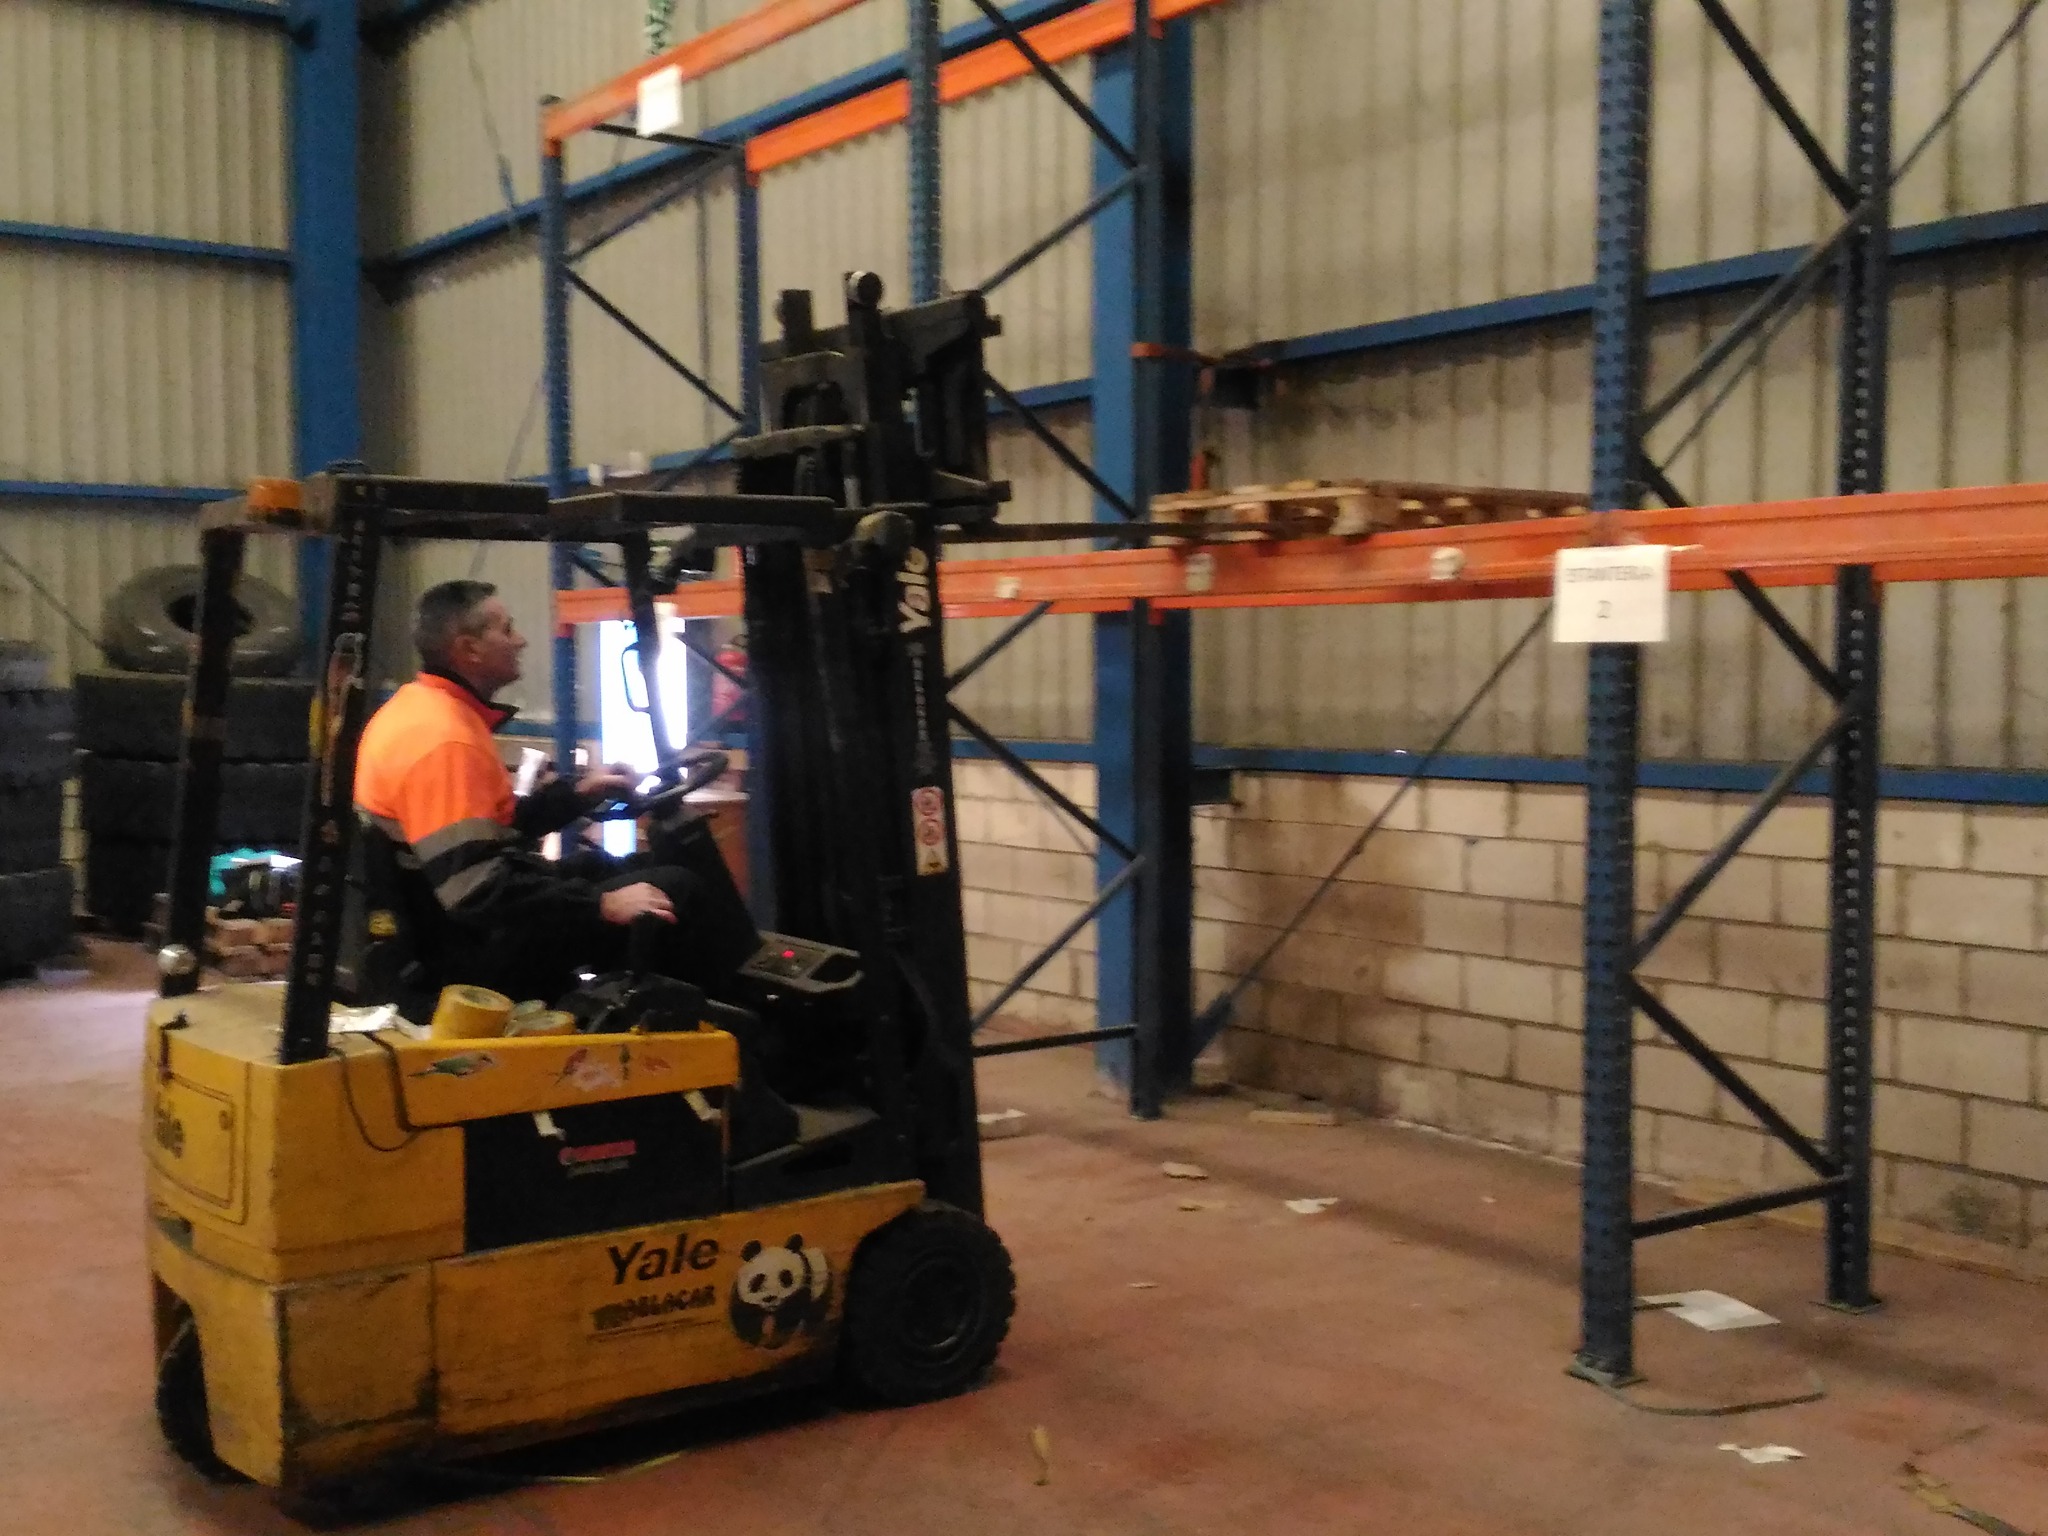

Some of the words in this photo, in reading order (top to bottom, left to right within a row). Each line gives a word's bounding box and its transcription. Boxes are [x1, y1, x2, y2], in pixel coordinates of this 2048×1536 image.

[895, 546, 932, 634] Yale
[1597, 600, 1612, 619] 2
[607, 1232, 720, 1285] Yale
